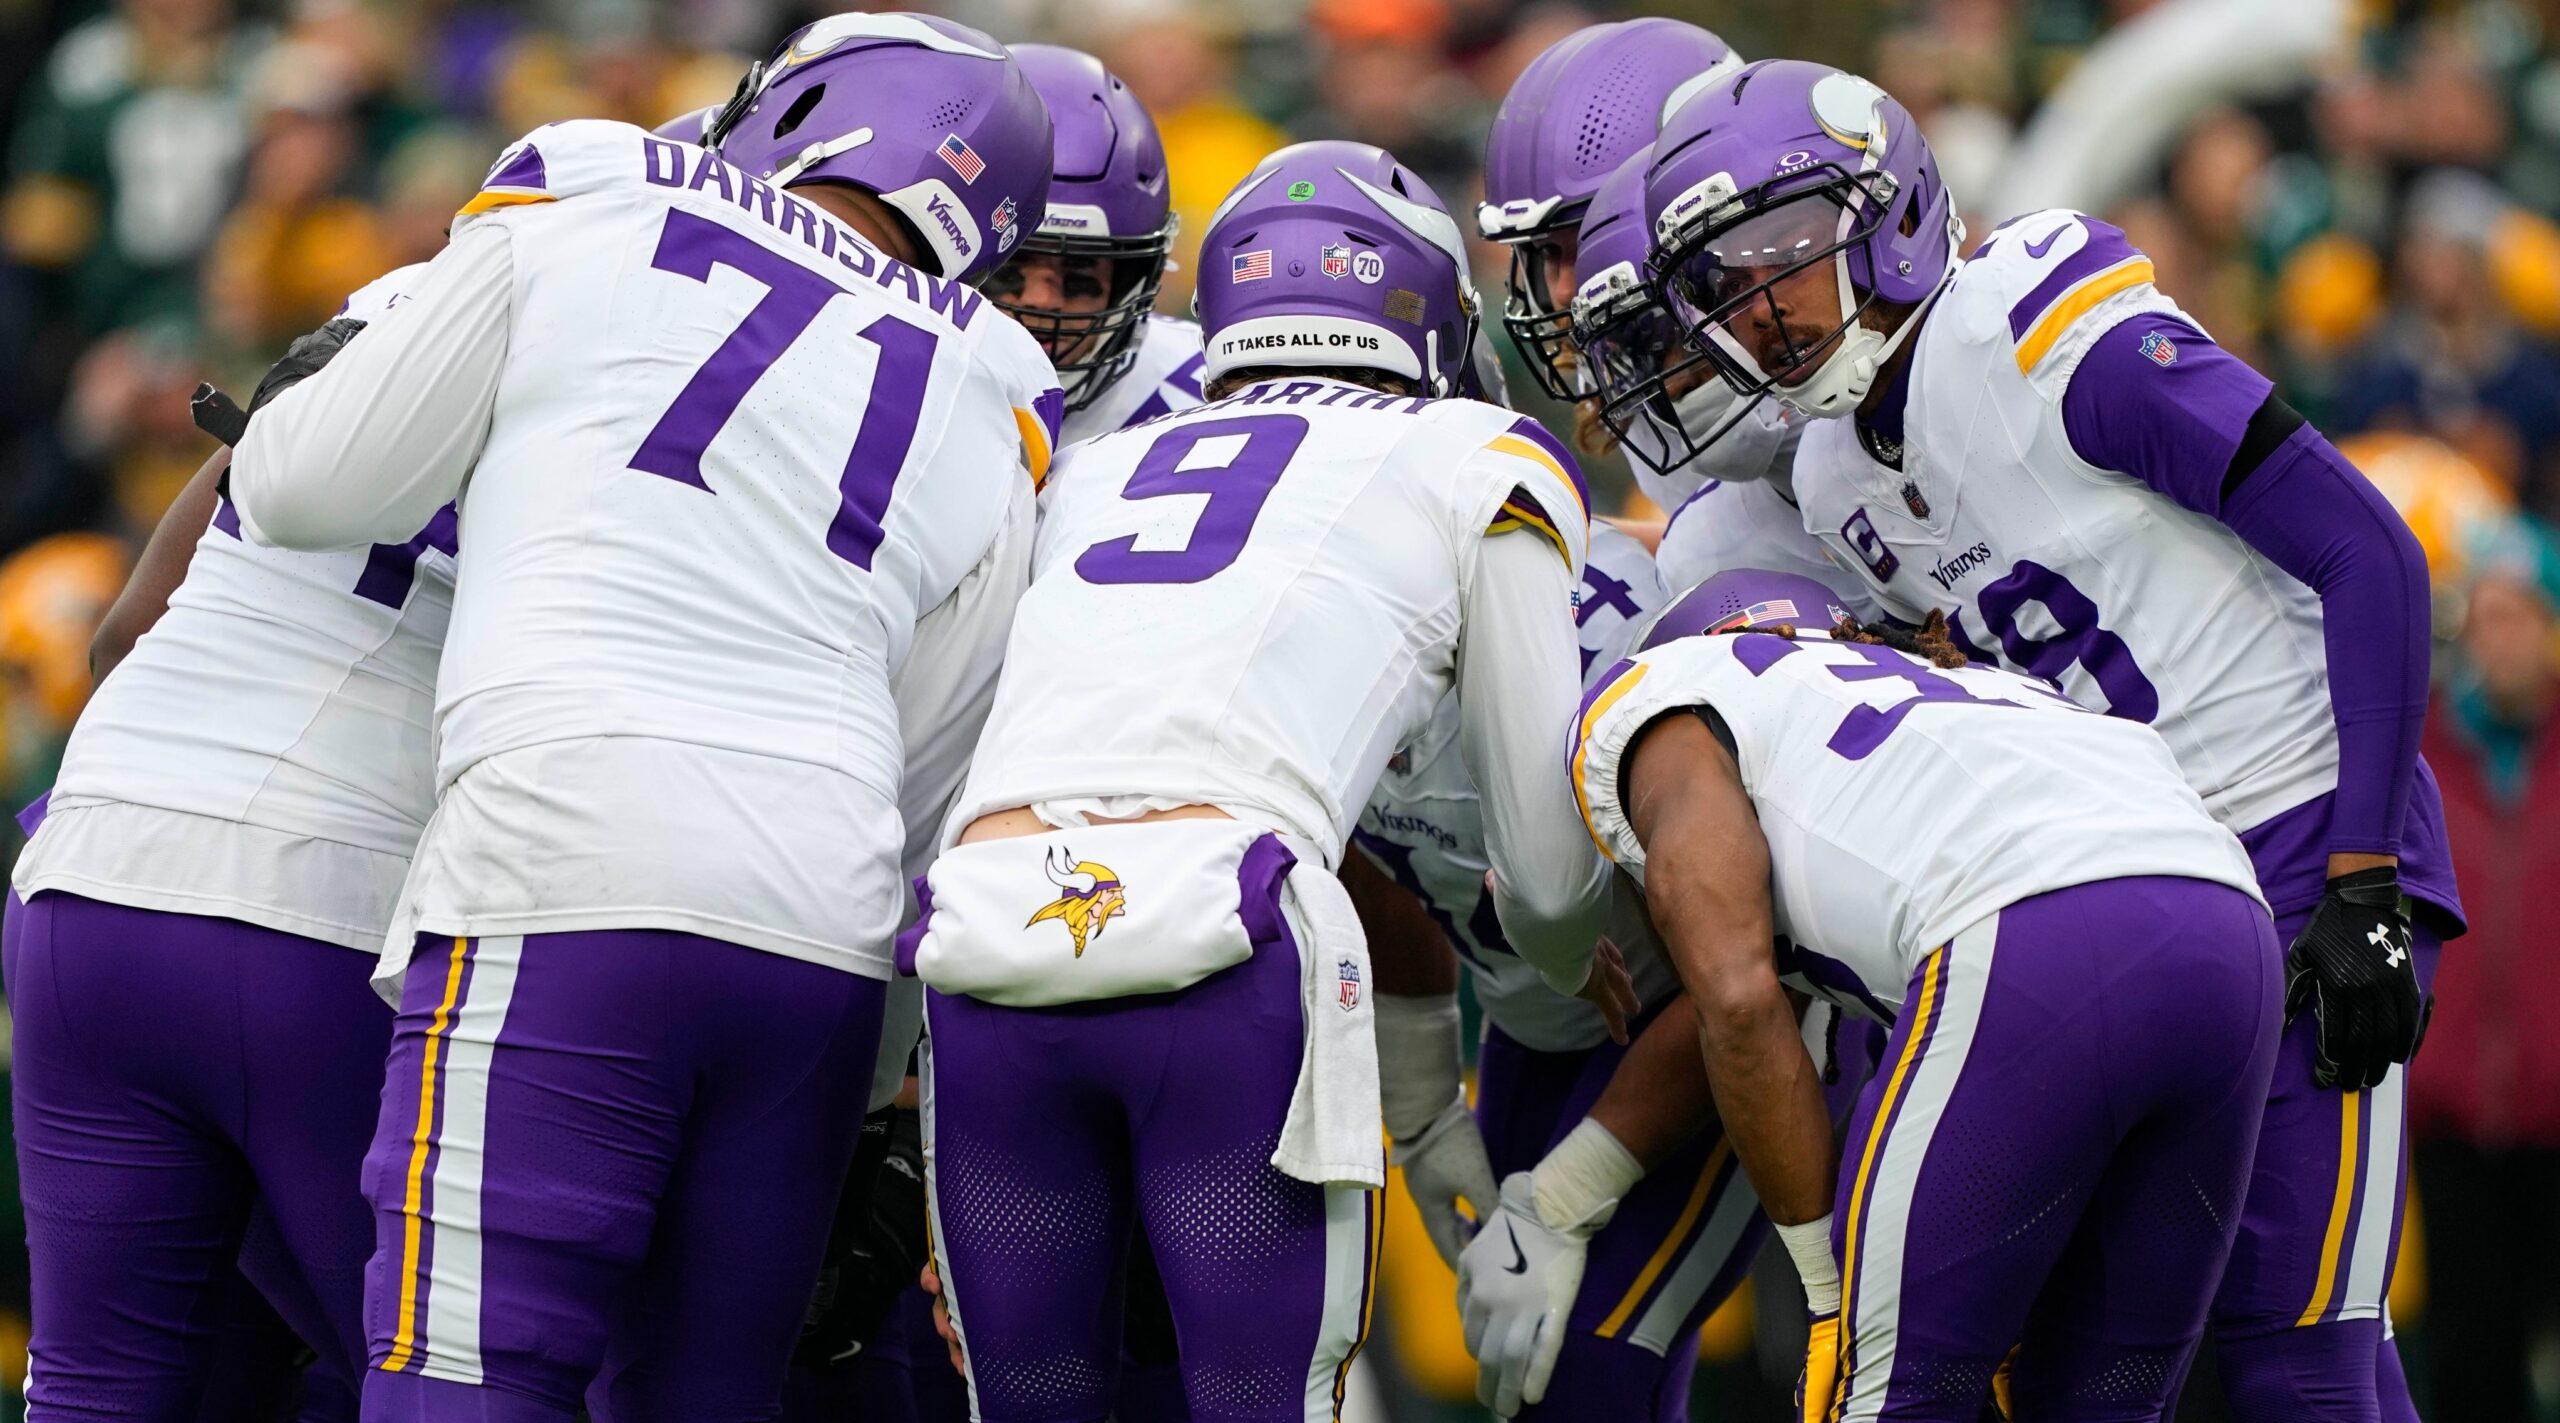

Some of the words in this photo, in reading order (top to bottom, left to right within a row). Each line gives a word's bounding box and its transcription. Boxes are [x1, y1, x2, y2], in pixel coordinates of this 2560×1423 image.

[643, 137, 983, 332] DARRISAW
[1325, 259, 1347, 274] NFL
[1358, 257, 1380, 278] 70
[1222, 341, 1235, 355] IT
[1238, 334, 1286, 351] TAKES
[1290, 333, 1324, 347] ALL
[1328, 333, 1351, 348] OF
[1356, 336, 1380, 350] US
[626, 206, 940, 573] 71
[1074, 413, 1310, 585] 9
[1846, 517, 1884, 567] C
